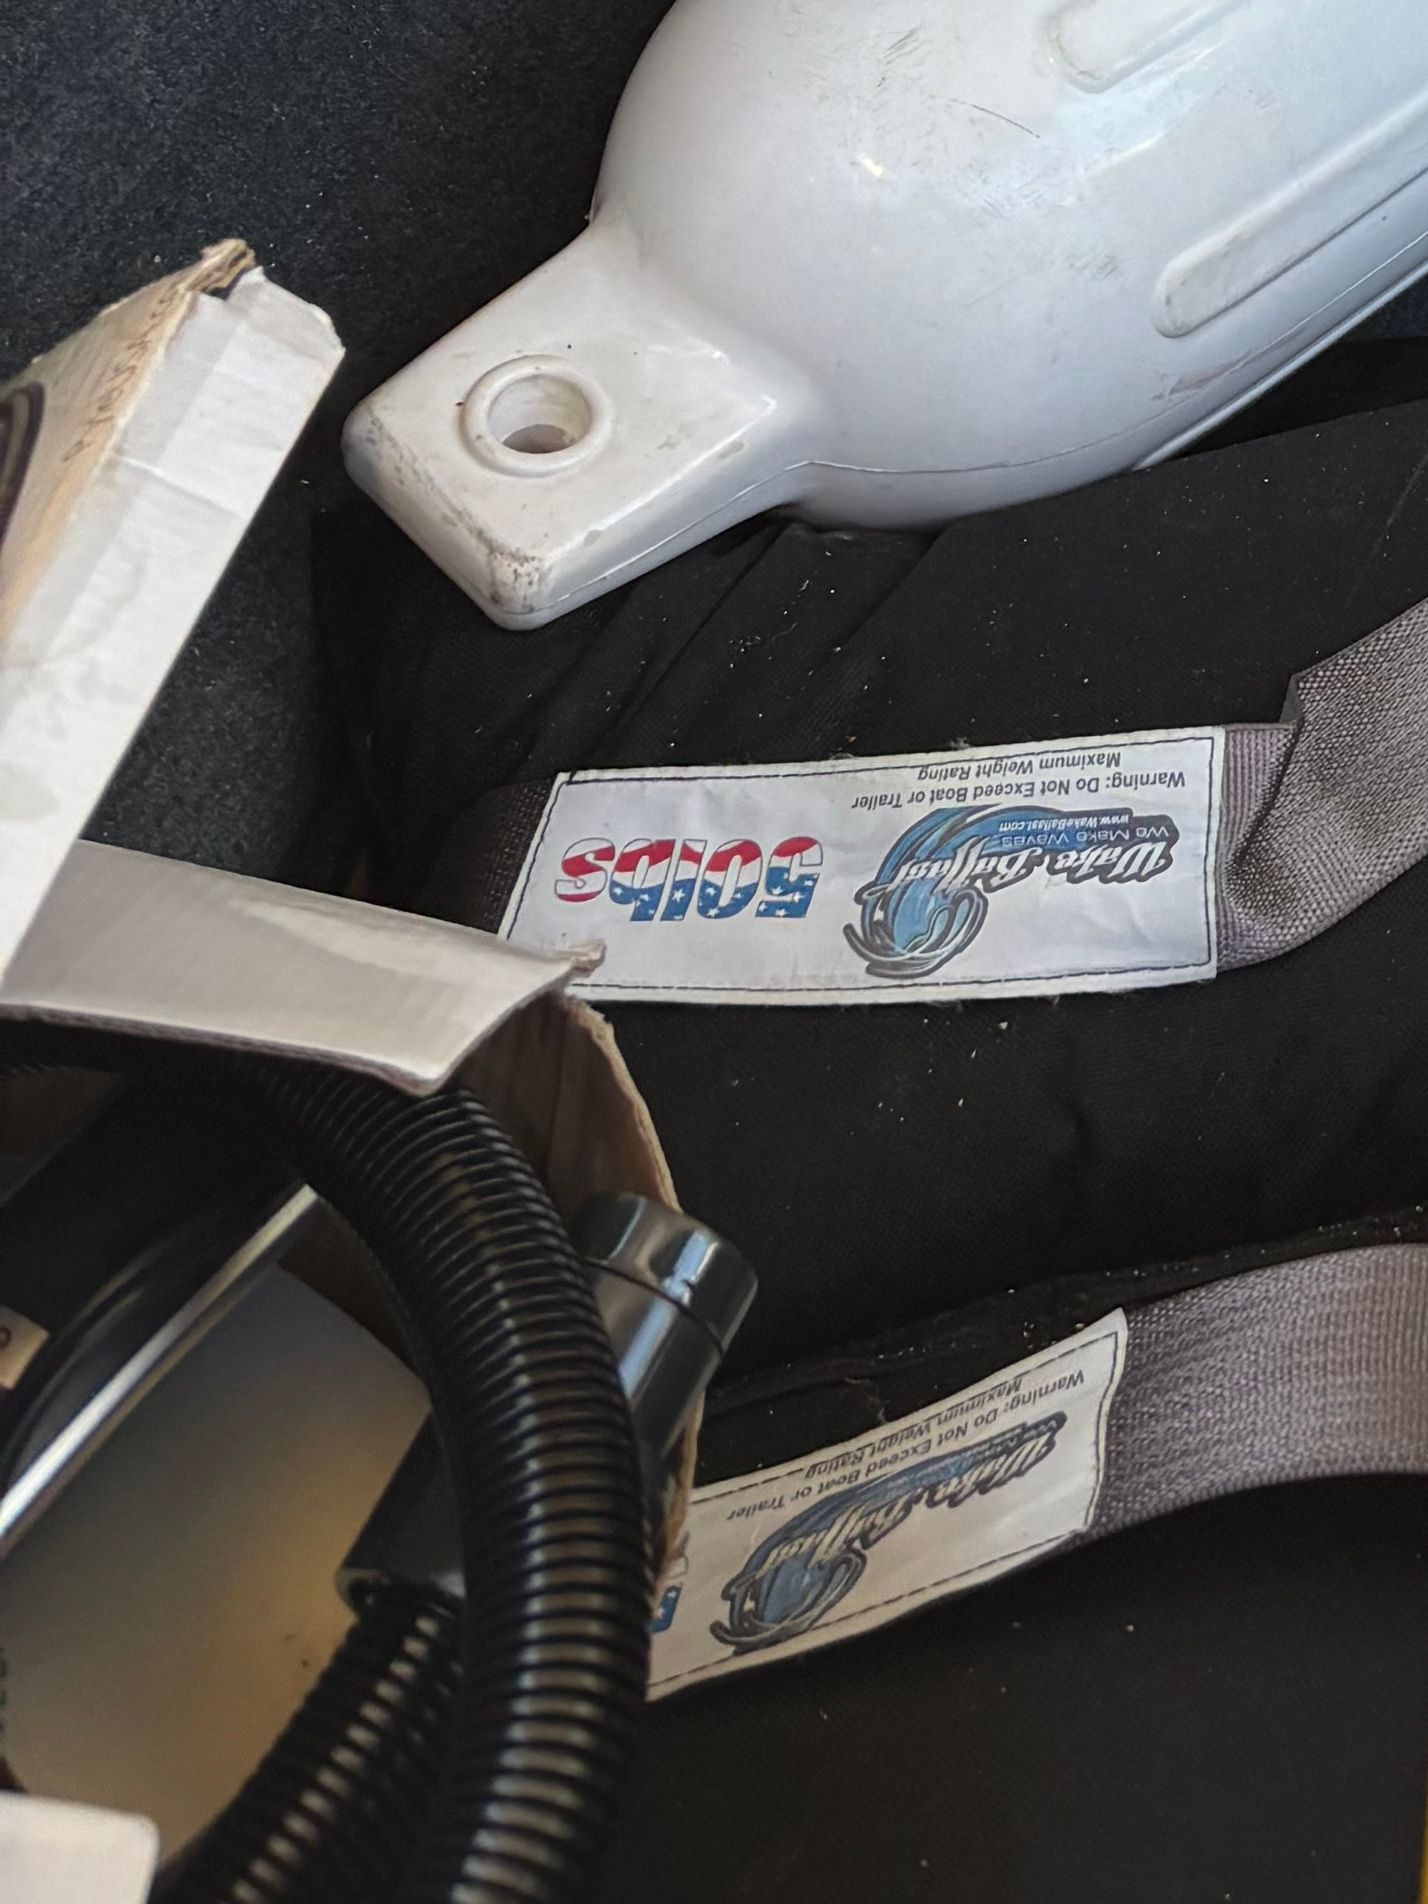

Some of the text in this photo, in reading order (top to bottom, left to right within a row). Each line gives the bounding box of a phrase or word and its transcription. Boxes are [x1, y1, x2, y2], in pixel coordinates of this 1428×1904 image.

[918, 752, 1121, 781] Maximum Weight Rating
[851, 772, 1186, 809] Warning: Do Not Exceed Boat or Trailer
[1001, 833, 1070, 847] Waves
[1076, 829, 1130, 842] Make
[553, 836, 824, 922] 50lbs
[858, 837, 1166, 901] Wake Ballast
[726, 1368, 1085, 1521] Warning: Do Not Exceed Boat or Trailer
[804, 1448, 864, 1479] Rating
